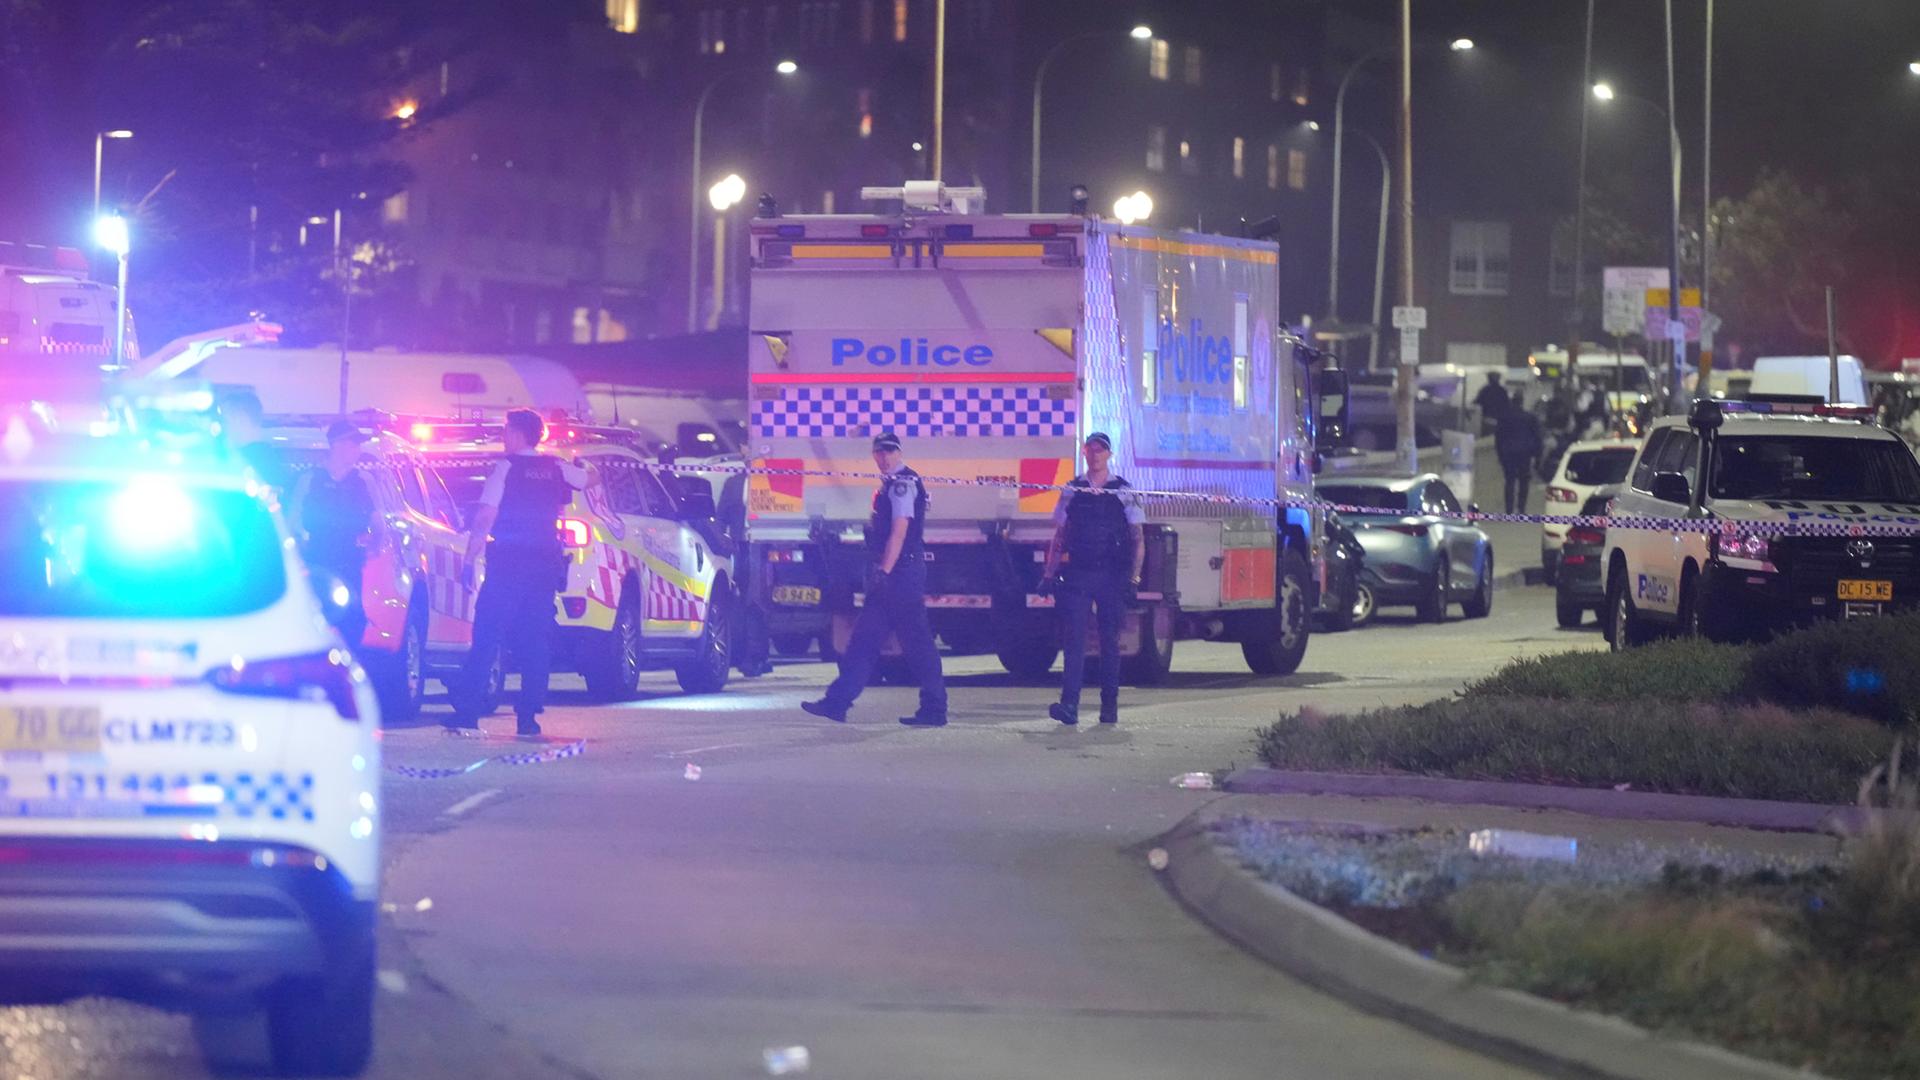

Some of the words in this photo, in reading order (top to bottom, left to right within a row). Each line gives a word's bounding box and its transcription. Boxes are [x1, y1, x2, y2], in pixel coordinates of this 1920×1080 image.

[831, 338, 993, 367] Police
[1159, 317, 1232, 384] Police
[1787, 511, 1920, 525] Police
